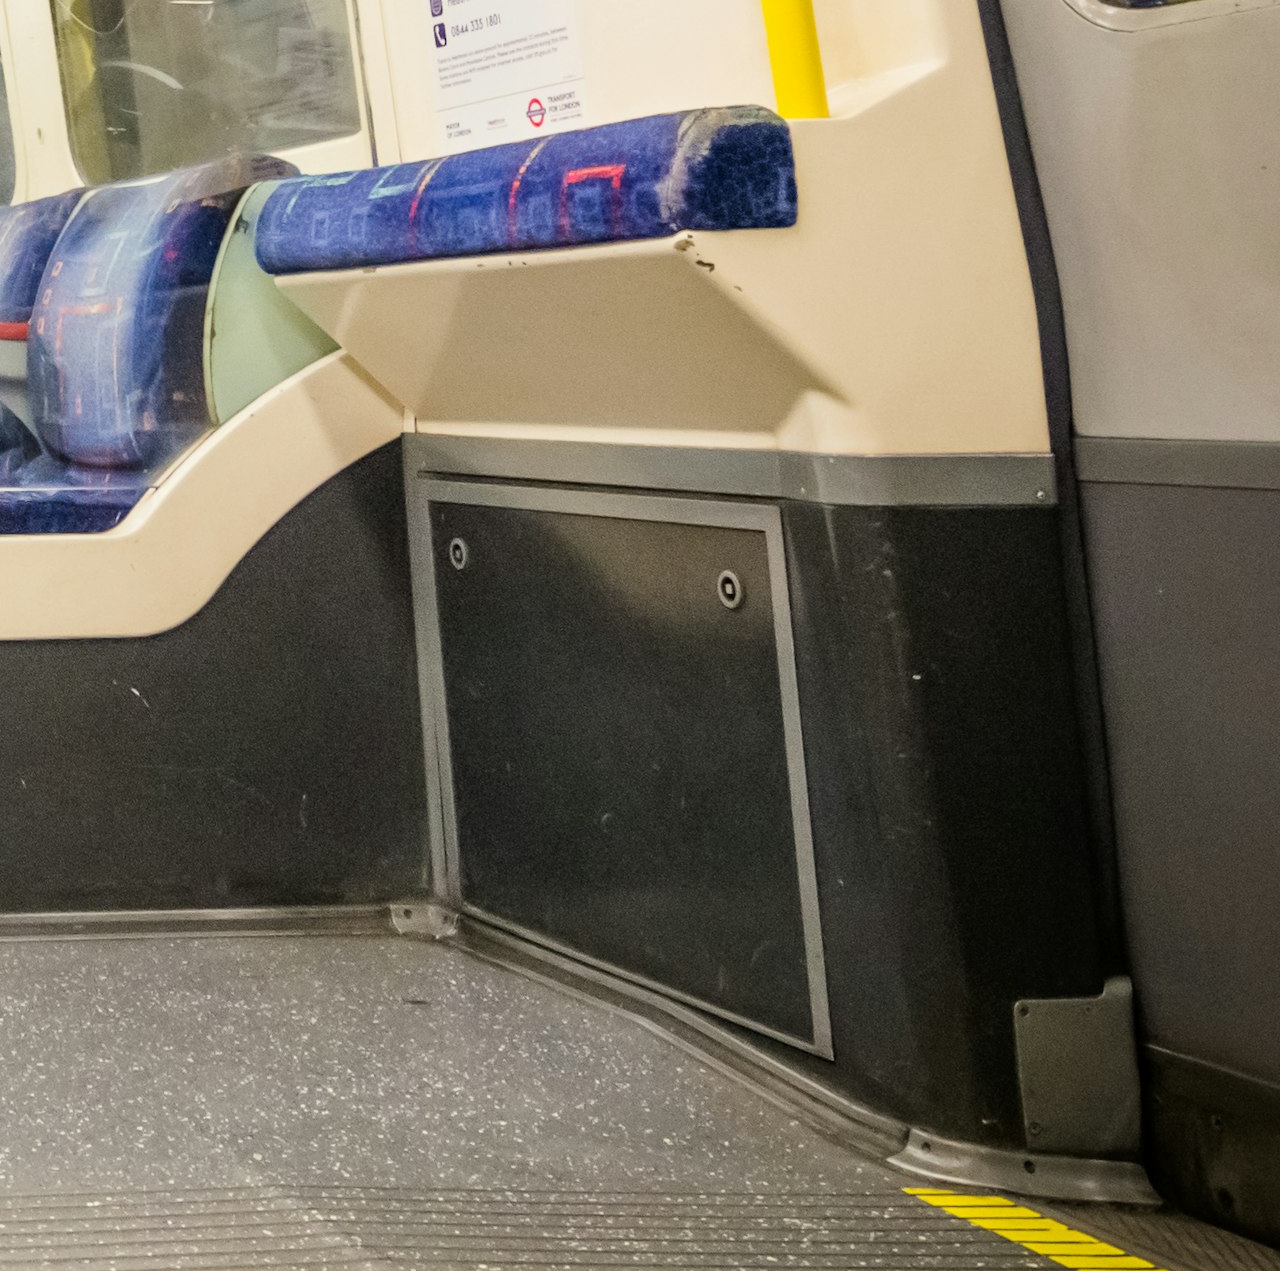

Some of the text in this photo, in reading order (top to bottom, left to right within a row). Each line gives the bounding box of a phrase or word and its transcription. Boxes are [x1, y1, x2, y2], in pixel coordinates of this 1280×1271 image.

[451, 13, 501, 37] 0844 335 1801
[548, 91, 575, 103] TRANSPORT
[559, 101, 580, 112] LONDON
